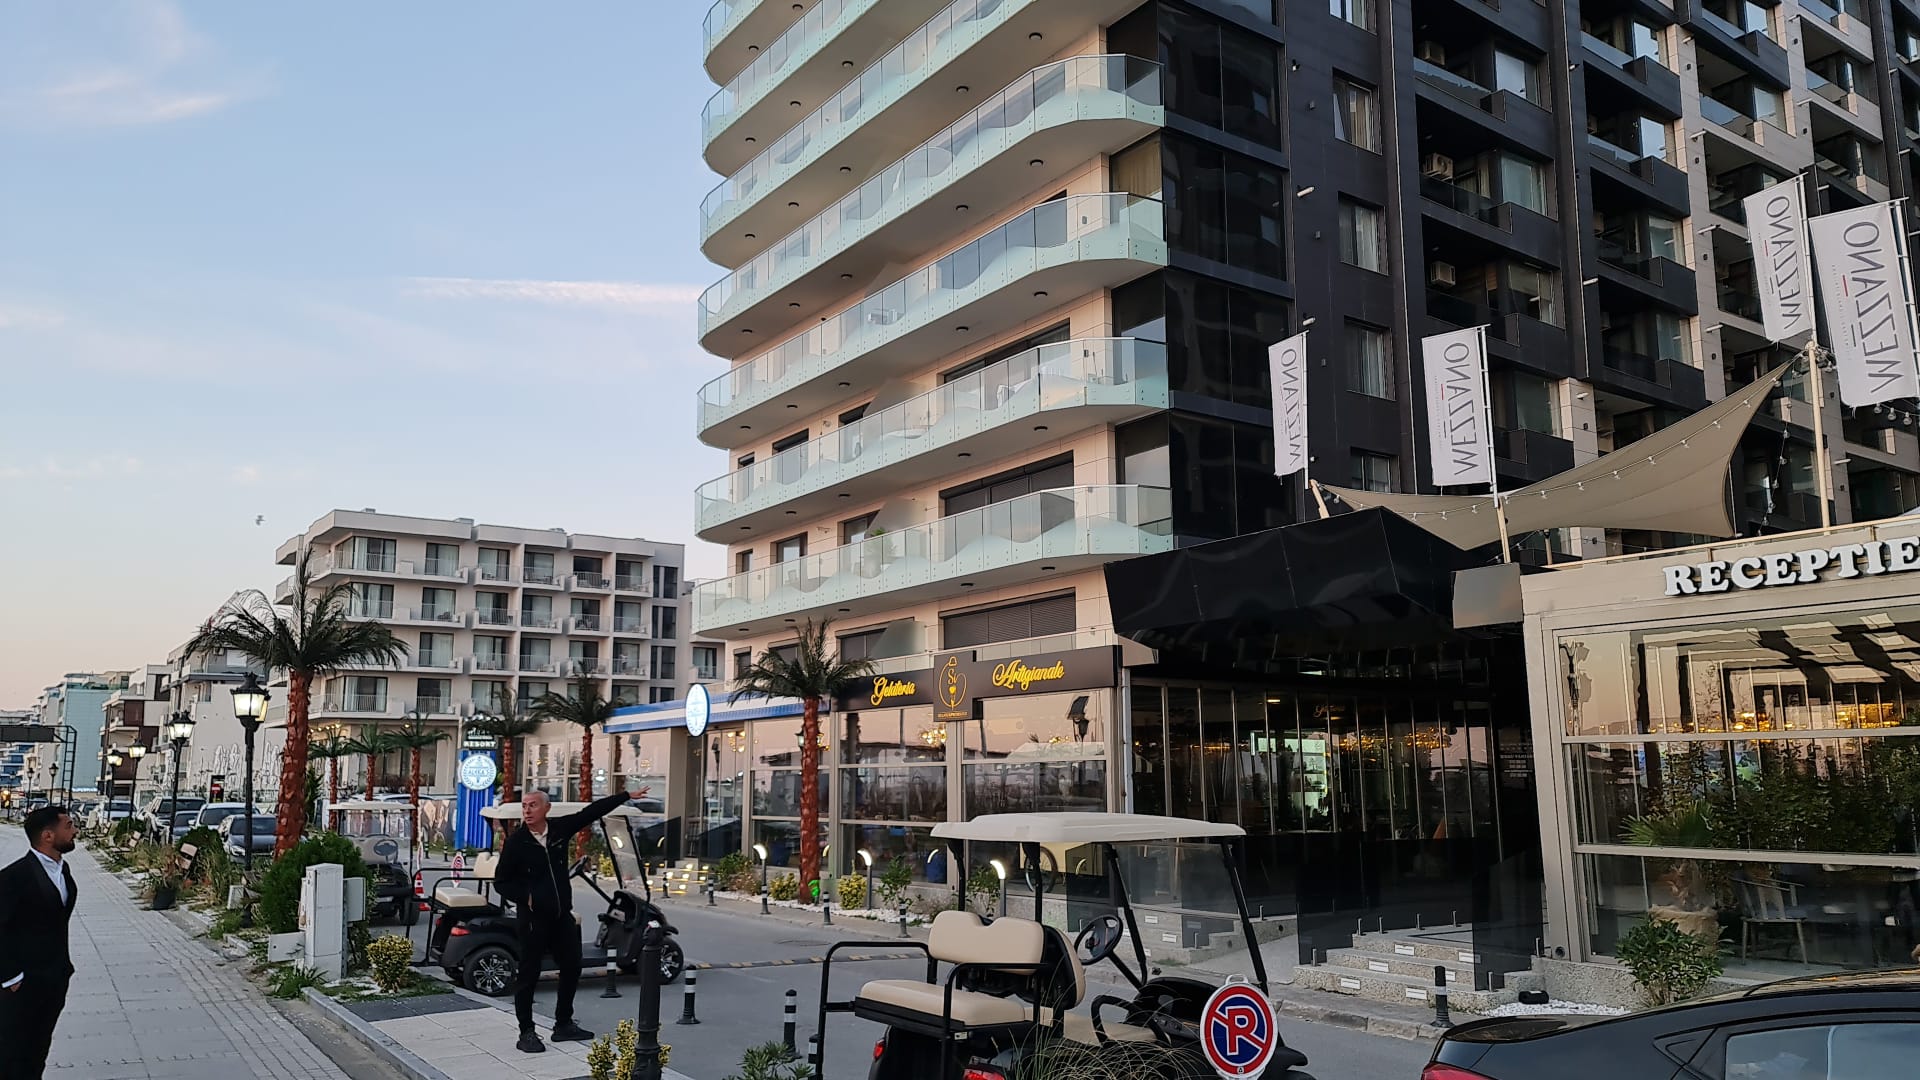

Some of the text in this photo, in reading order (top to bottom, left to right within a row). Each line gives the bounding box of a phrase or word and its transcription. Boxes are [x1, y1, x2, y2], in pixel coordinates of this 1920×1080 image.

[1662, 535, 1920, 597] RECEPTIE
[870, 676, 916, 706] Gelateria
[992, 659, 1065, 691] Artigianale
